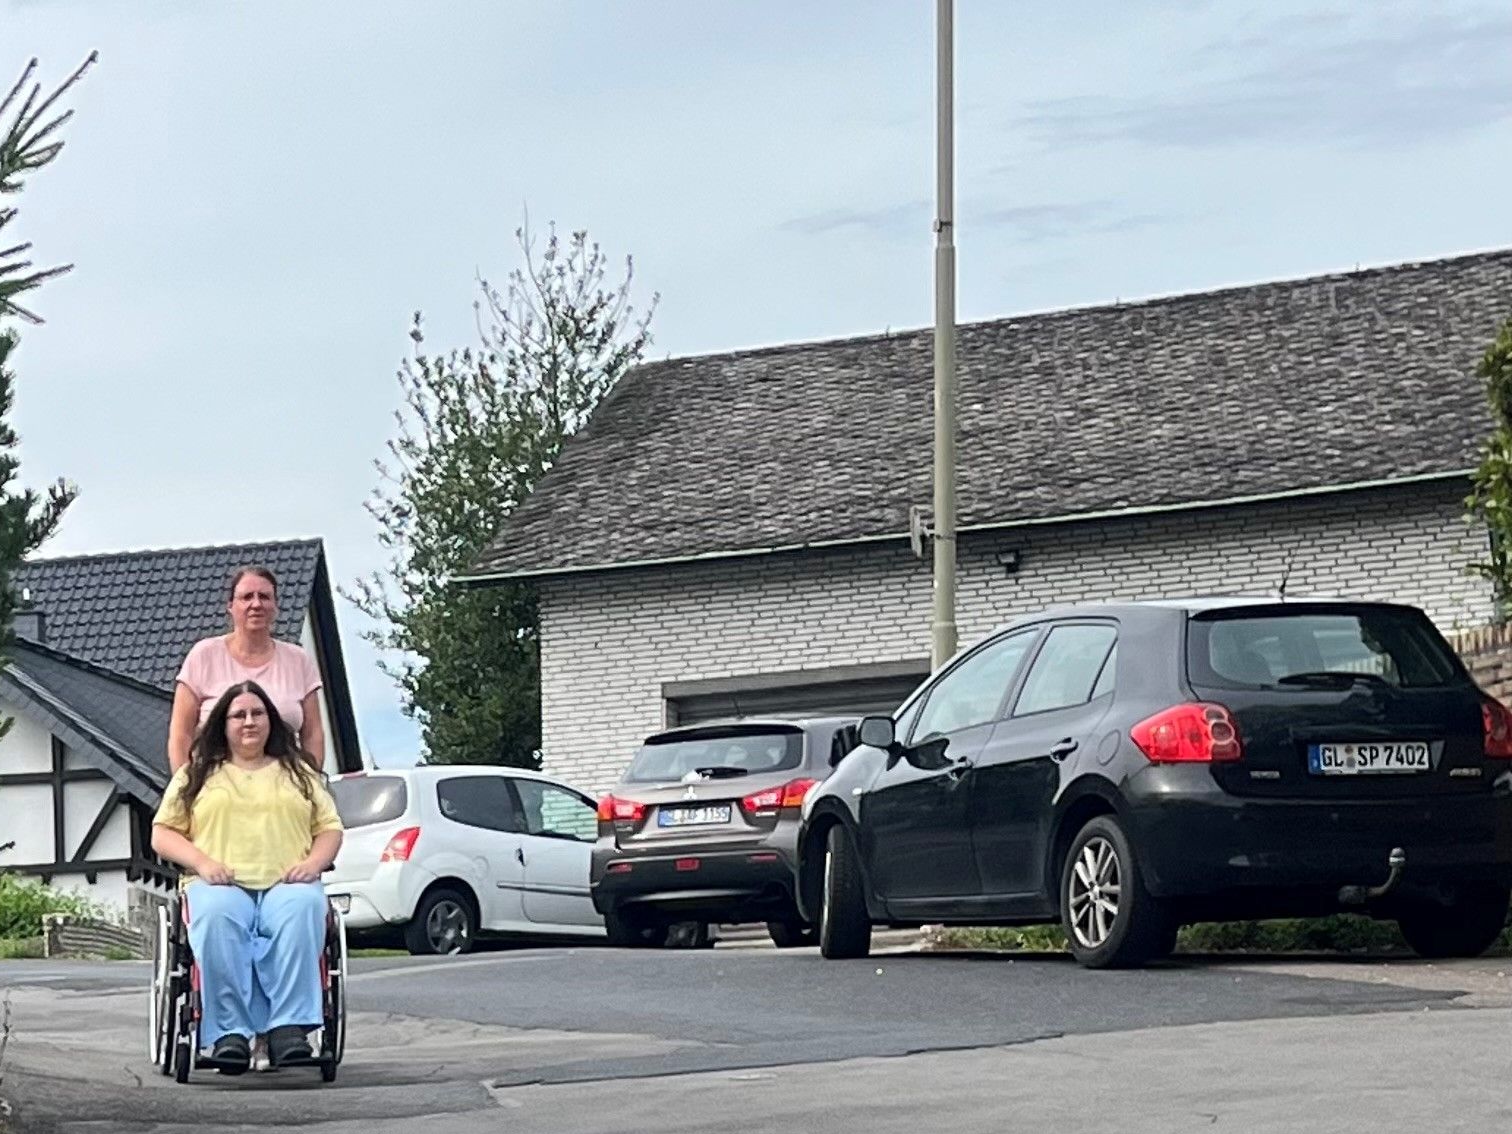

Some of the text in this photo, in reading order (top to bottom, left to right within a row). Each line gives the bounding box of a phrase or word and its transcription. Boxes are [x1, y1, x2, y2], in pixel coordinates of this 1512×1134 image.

[1321, 744, 1426, 768] GL SP 7402
